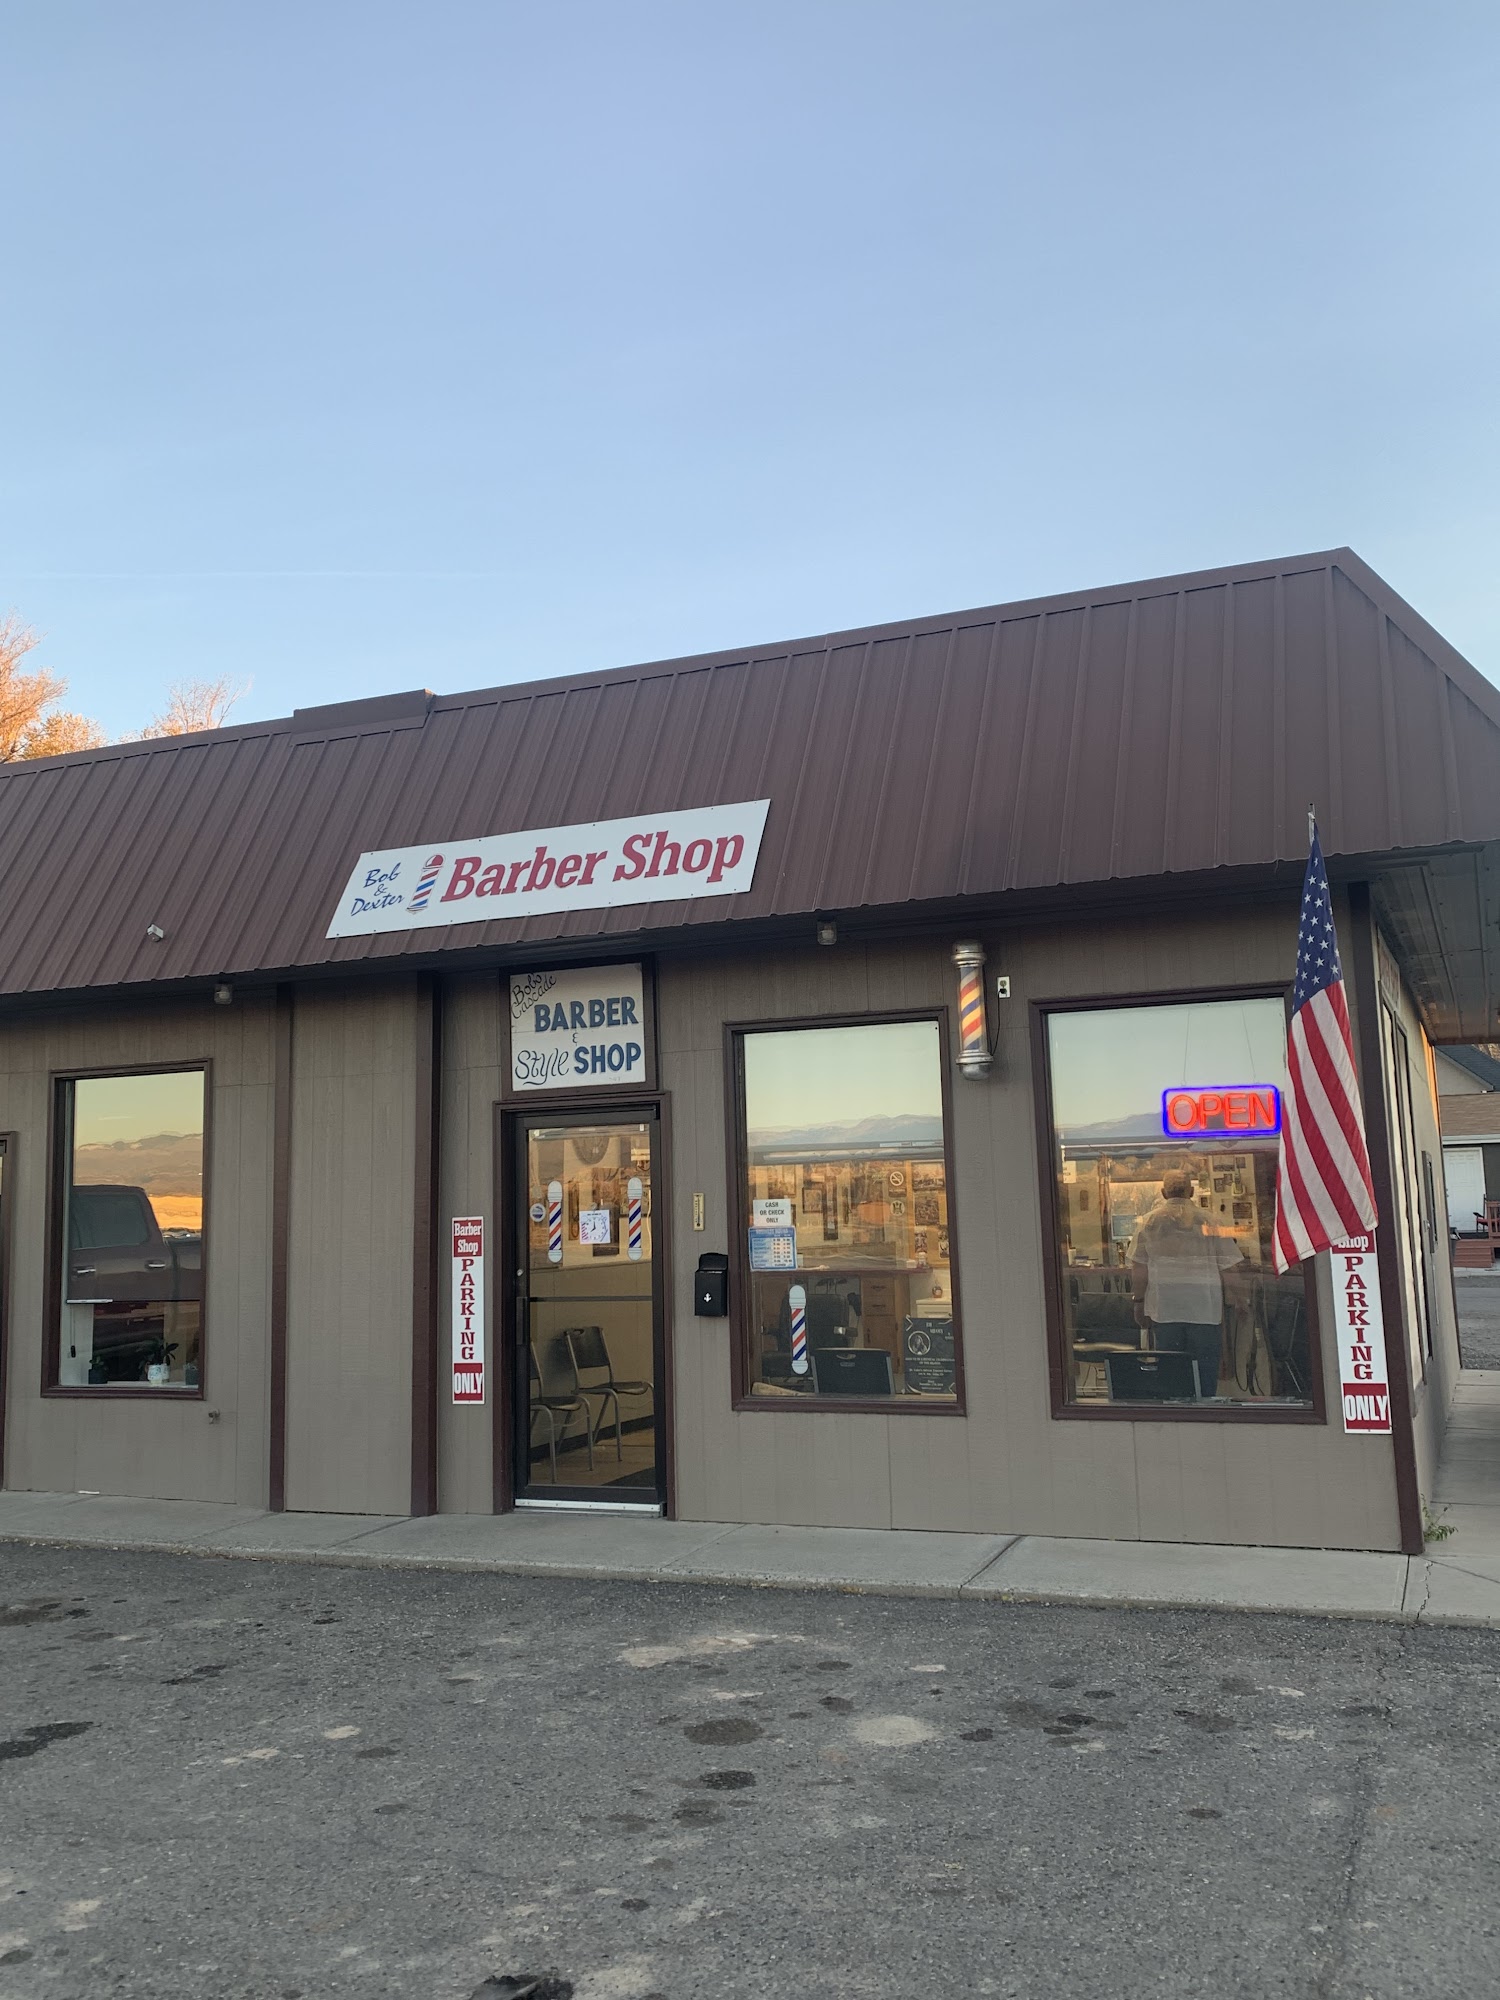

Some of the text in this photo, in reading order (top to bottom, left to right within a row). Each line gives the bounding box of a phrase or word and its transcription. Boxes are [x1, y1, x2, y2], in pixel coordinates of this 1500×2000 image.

[363, 862, 402, 888] Bob
[440, 830, 746, 903] Barber Shop
[350, 893, 406, 917] Dexter
[373, 883, 388, 896] &
[511, 974, 557, 1019] Cascade
[534, 996, 639, 1033] BARBER
[515, 1042, 641, 1085] Style SHOP
[1167, 1092, 1276, 1131] OPEN
[454, 1223, 482, 1237] Barber
[457, 1239, 479, 1256] Shop
[460, 1258, 476, 1360] PARKING
[1344, 1256, 1373, 1380] PARKING
[454, 1373, 483, 1394] ONLY
[1344, 1394, 1388, 1421] ONLY
